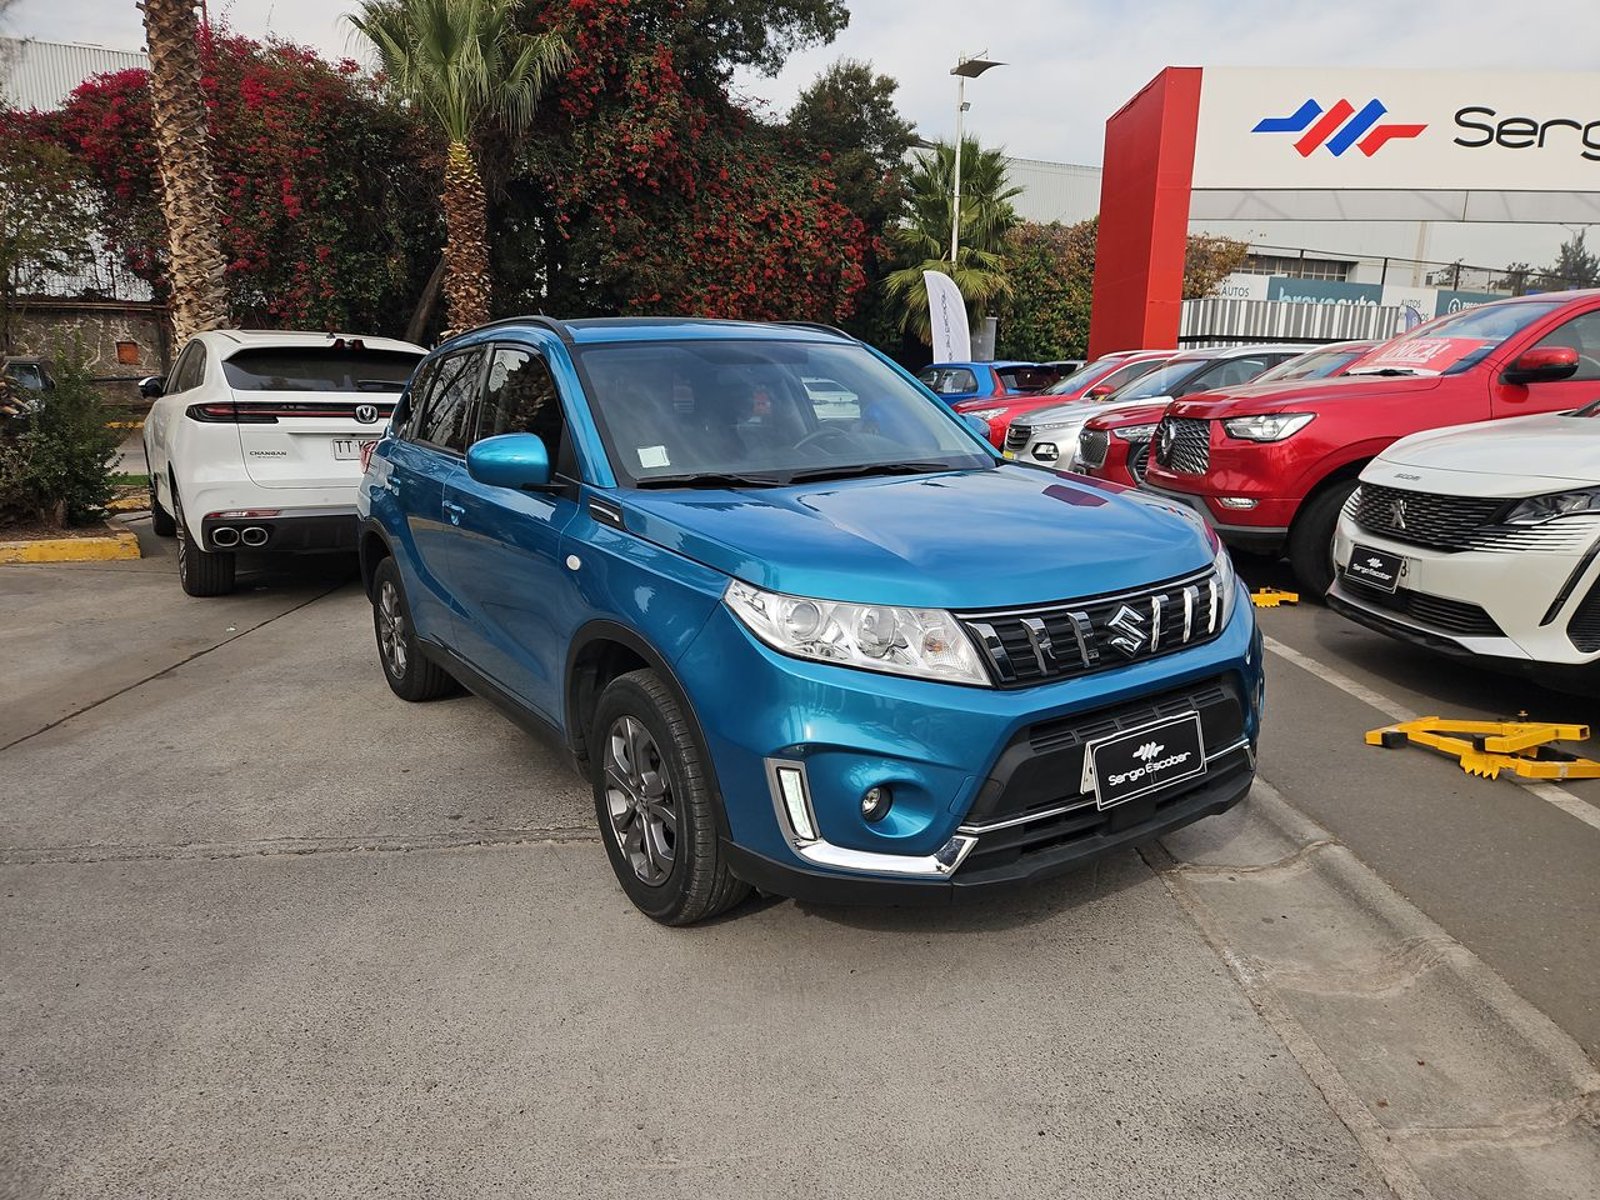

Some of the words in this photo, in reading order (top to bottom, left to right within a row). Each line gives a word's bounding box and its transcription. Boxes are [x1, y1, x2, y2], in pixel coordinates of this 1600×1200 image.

[1221, 285, 1250, 297] AUTOS
[1108, 767, 1145, 786] Sergo
[1145, 751, 1191, 773] Escobar
